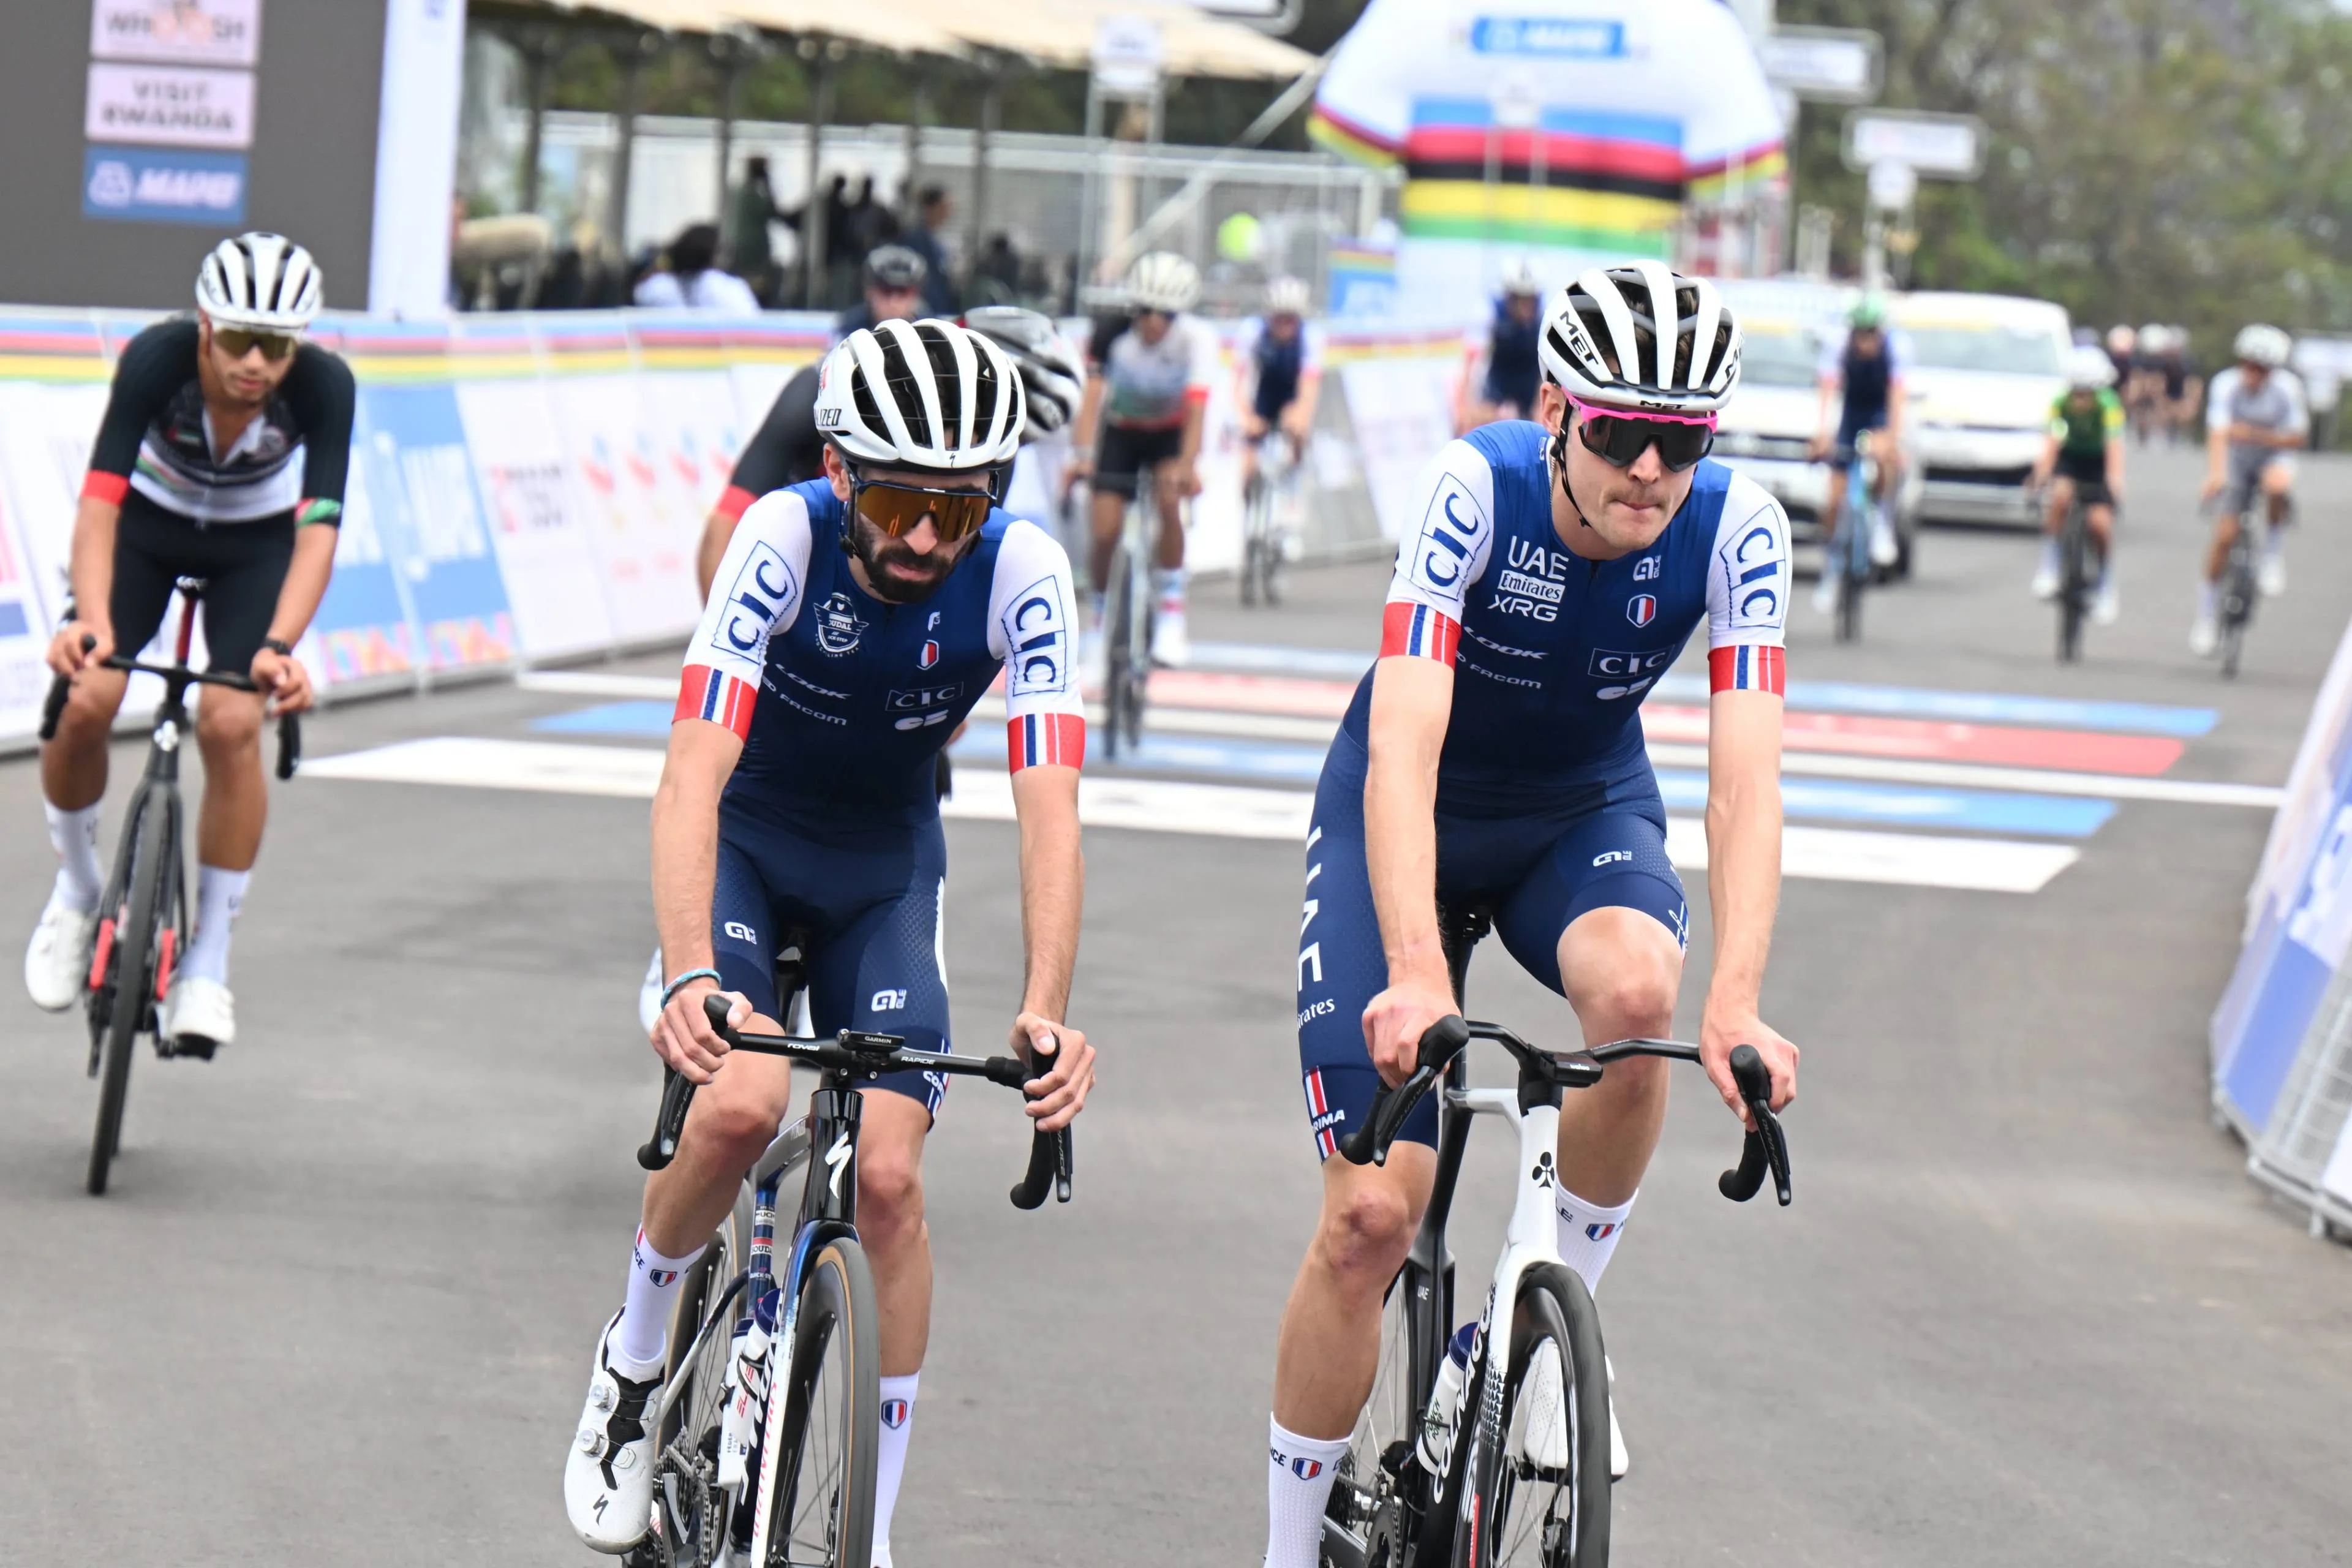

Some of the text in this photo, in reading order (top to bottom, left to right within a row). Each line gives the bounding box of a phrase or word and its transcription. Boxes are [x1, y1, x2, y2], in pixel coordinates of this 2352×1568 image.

[132, 80, 208, 102] VISIT
[100, 105, 236, 130] RWANDA
[137, 169, 239, 209] MAPEI
[1559, 311, 1599, 366] MET
[1640, 400, 1687, 410] MET
[1425, 492, 1480, 588] CIC
[1507, 535, 1569, 581] UAE
[1736, 527, 1779, 618] CIC
[1500, 573, 1561, 600] Emirates
[728, 559, 788, 652] CIC
[1487, 594, 1559, 622] XRG
[828, 619, 853, 631] UDAL
[1014, 596, 1057, 684] CIC
[1463, 626, 1550, 660] LOOK
[1470, 663, 1542, 690] FACOM
[1599, 652, 1666, 674] CIC
[775, 663, 853, 700] LOOK
[779, 693, 847, 726] FACOM
[895, 687, 956, 707] CIC
[1298, 998, 1336, 1032] irates
[864, 1035, 892, 1044] GARMIN
[900, 1056, 936, 1065] RAPIDE
[1312, 1109, 1346, 1134] RIMA
[1433, 1291, 1491, 1505] COLNAGO
